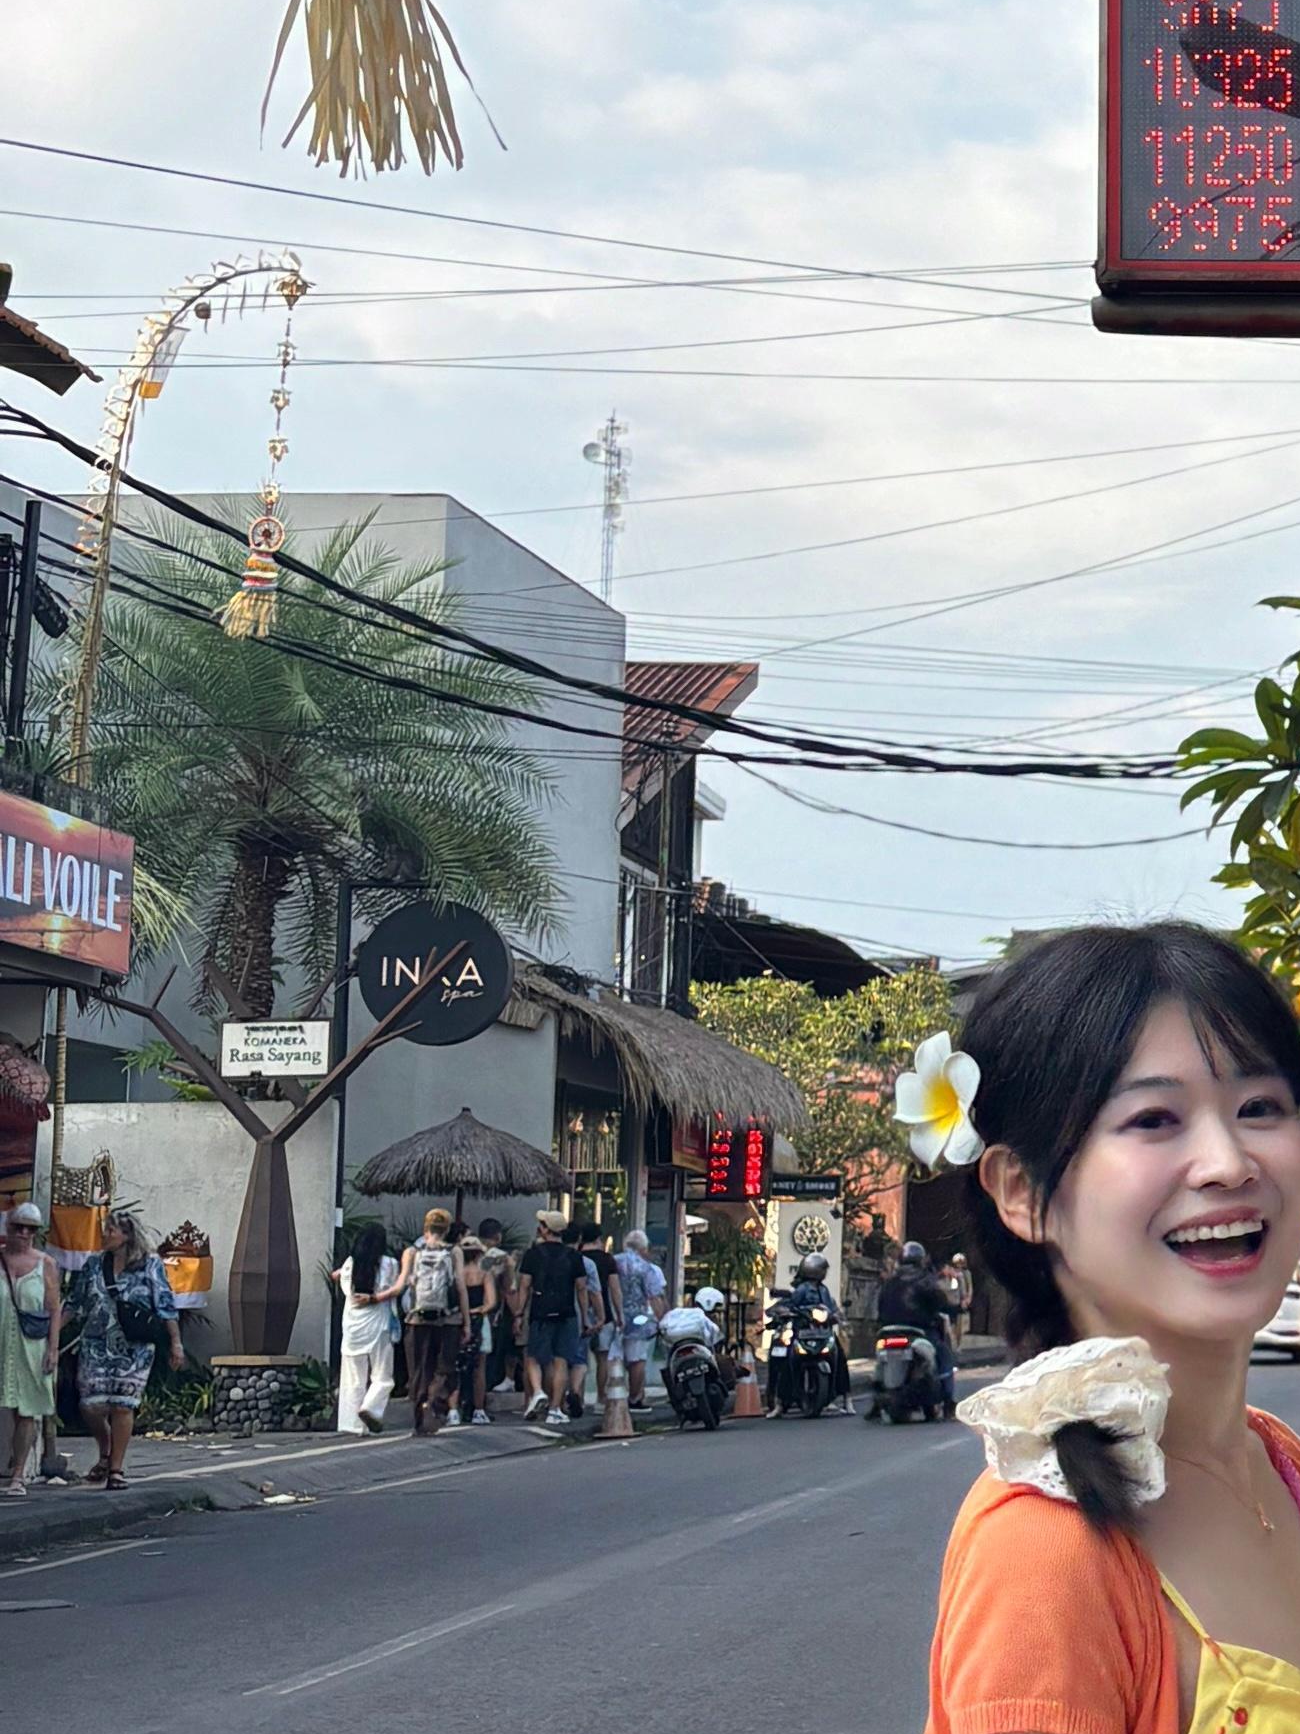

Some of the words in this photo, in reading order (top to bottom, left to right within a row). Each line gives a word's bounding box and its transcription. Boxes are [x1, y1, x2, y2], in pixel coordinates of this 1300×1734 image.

[1144, 125, 1294, 187] 11250
[0, 833, 34, 905] LI
[43, 847, 123, 932] VOILE
[381, 956, 484, 986] INA
[440, 989, 484, 1007] spa
[229, 1048, 264, 1063] Rasa
[267, 1048, 322, 1066] Sayang
